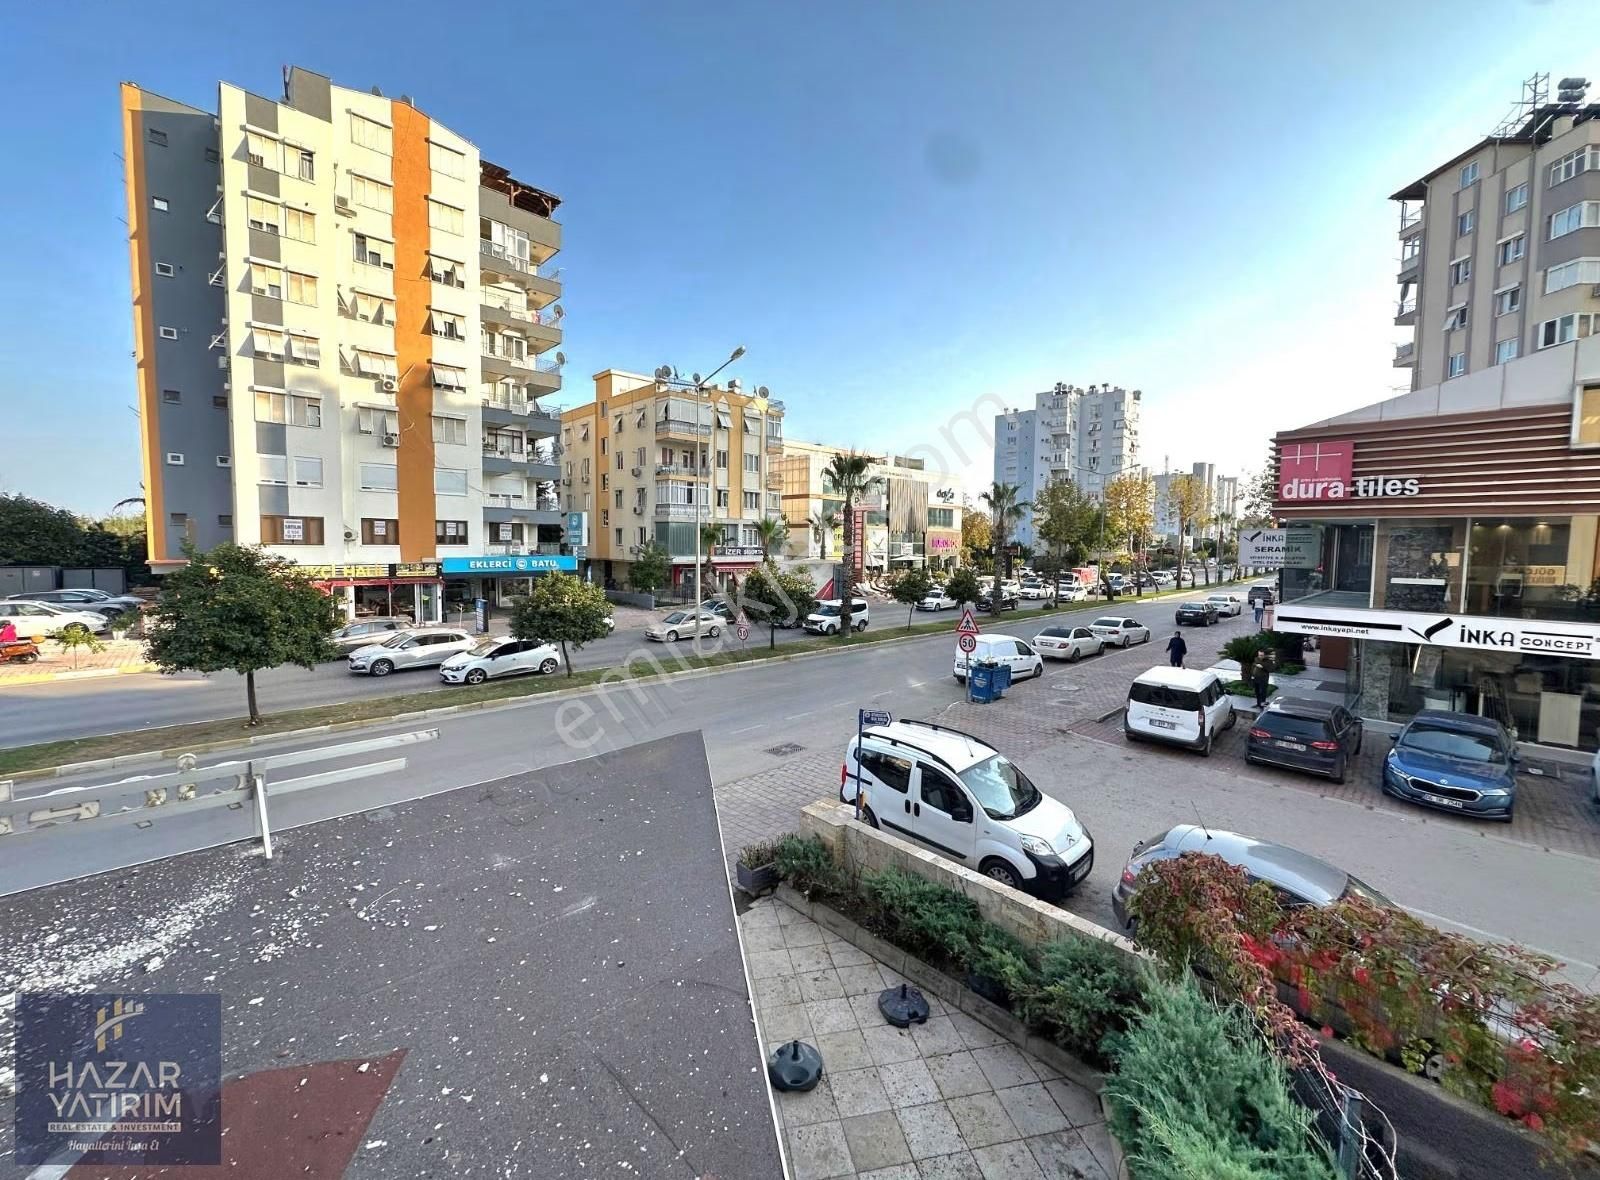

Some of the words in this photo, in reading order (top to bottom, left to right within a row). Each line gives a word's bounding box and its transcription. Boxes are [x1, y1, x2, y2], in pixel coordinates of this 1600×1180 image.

[1263, 533, 1284, 542] İNKA
[1254, 545, 1302, 553] SERAMİK
[469, 558, 512, 569] EKLERCİ
[1460, 624, 1514, 647] İNKA
[1520, 636, 1593, 651] CONCEPT
[962, 639, 973, 648] 50
